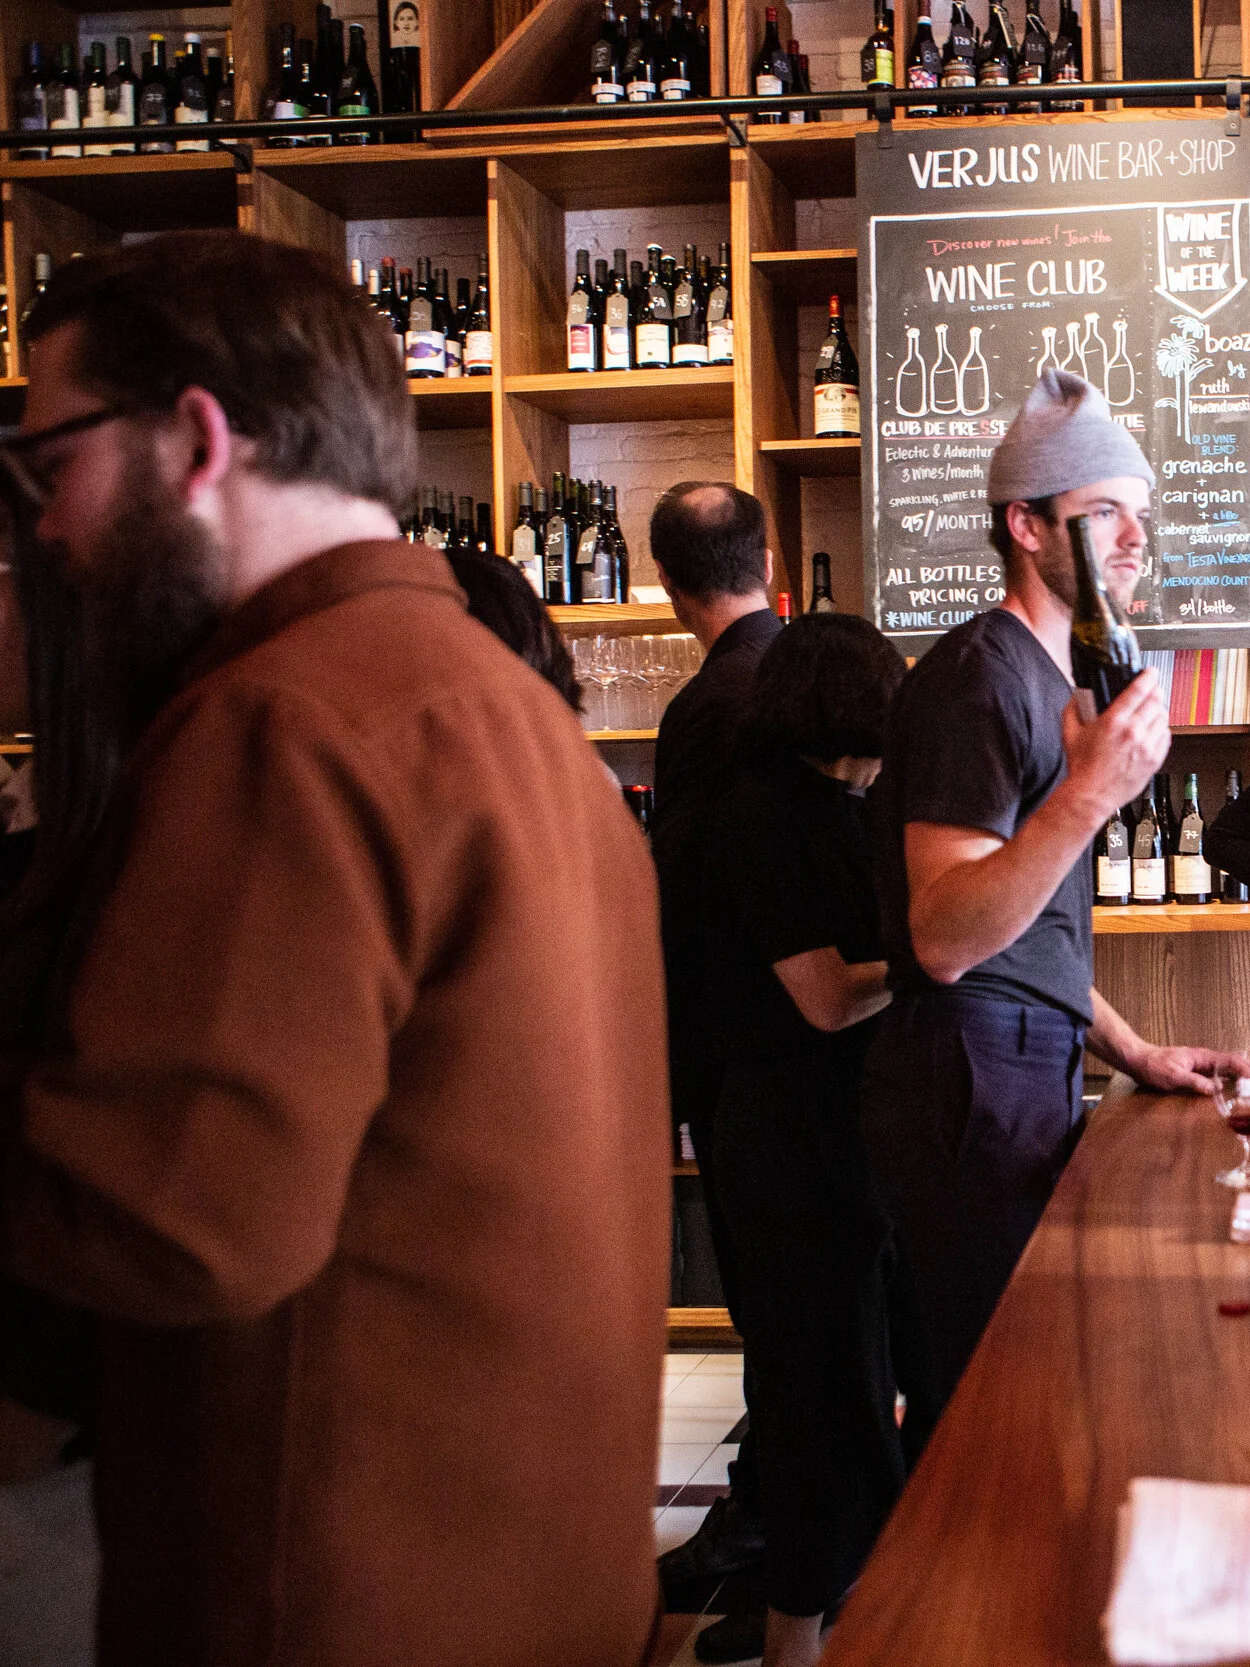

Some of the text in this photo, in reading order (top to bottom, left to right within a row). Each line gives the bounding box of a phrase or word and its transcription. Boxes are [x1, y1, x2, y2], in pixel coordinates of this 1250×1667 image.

[908, 143, 1040, 189] VERJUS
[1049, 142, 1112, 184] WINE
[1165, 211, 1232, 242] WINE
[926, 239, 993, 256] Discover
[996, 237, 1019, 248] new
[1062, 229, 1089, 247] Join
[1090, 229, 1113, 244] the
[1180, 245, 1217, 259] OF THE
[925, 259, 1107, 303] WINE CLUB
[1166, 262, 1230, 293] WEEK
[970, 303, 1015, 312] CHOOSE
[1227, 360, 1247, 379] by
[1200, 377, 1230, 395] ruth
[881, 420, 921, 436] CLUB
[924, 420, 945, 436] DE
[1191, 433, 1236, 445] OLD VINE
[885, 443, 995, 462] Eclectic & Adventur
[901, 468, 911, 483] 3
[1162, 456, 1248, 479] grenache
[977, 489, 988, 499] RE
[1162, 488, 1244, 508] carignan
[1158, 522, 1210, 536] cabernet
[1162, 551, 1184, 563] from
[1186, 552, 1217, 568] TESTA
[886, 565, 1002, 586] ALL BOTTLES
[1162, 574, 1219, 588] MENDOCINO
[908, 587, 978, 608] PRICING
[1109, 834, 1124, 848] 35
[1137, 833, 1153, 847] 45
